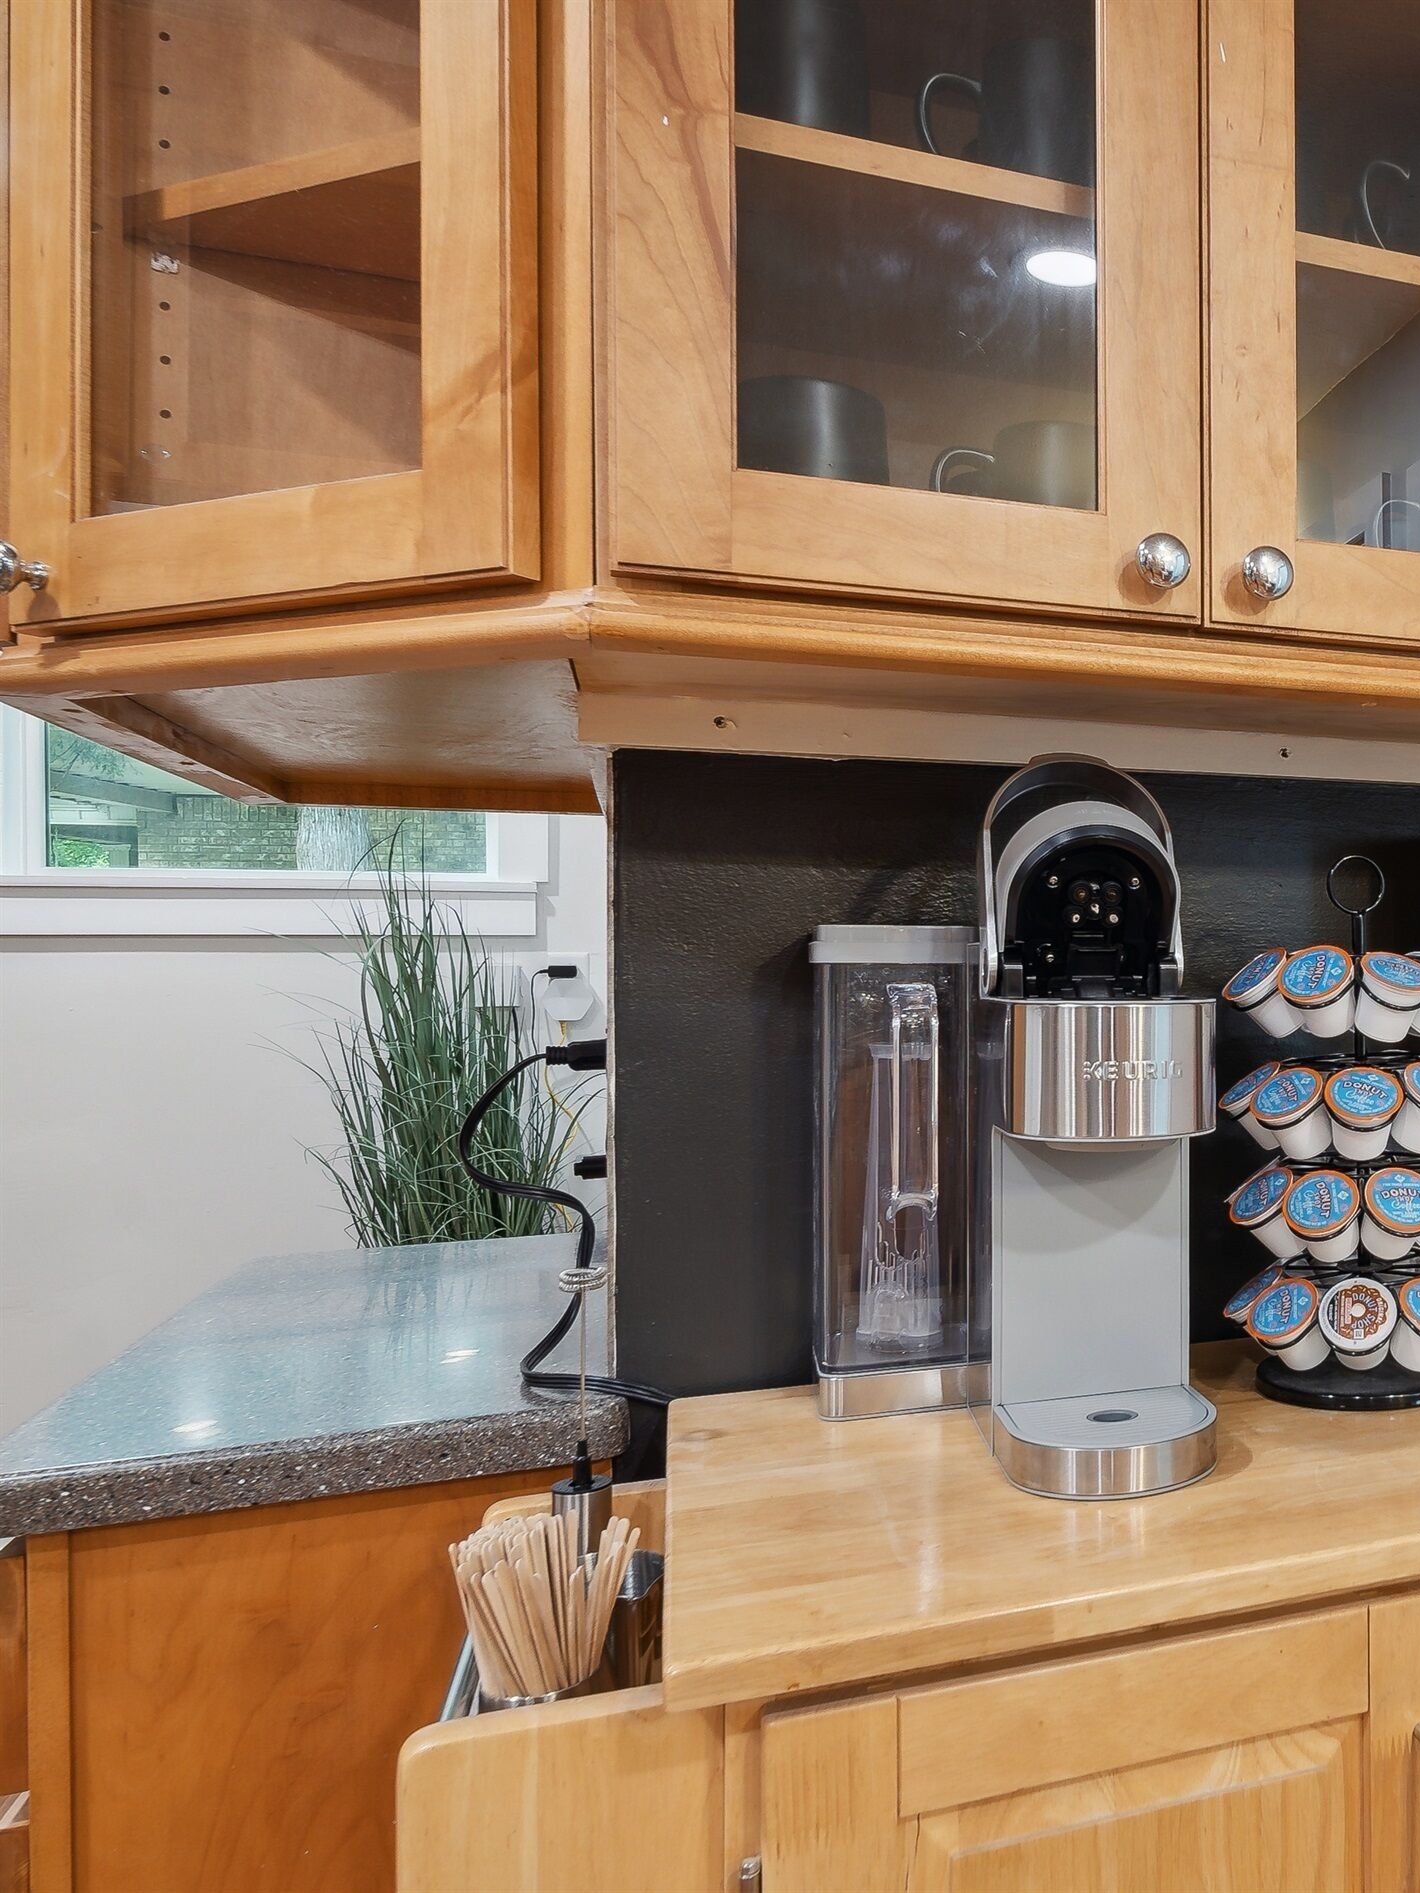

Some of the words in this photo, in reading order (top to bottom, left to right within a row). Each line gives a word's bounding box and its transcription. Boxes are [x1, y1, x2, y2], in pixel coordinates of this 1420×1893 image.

[1308, 955, 1326, 989] DONUT
[1082, 1060, 1183, 1081] KEURIG
[1343, 1080, 1387, 1099] DONUT
[1315, 1181, 1331, 1218] DONUT
[1279, 1289, 1291, 1324] DONUT
[1352, 1292, 1377, 1312] DONUT
[1352, 1313, 1376, 1329] SHOP
